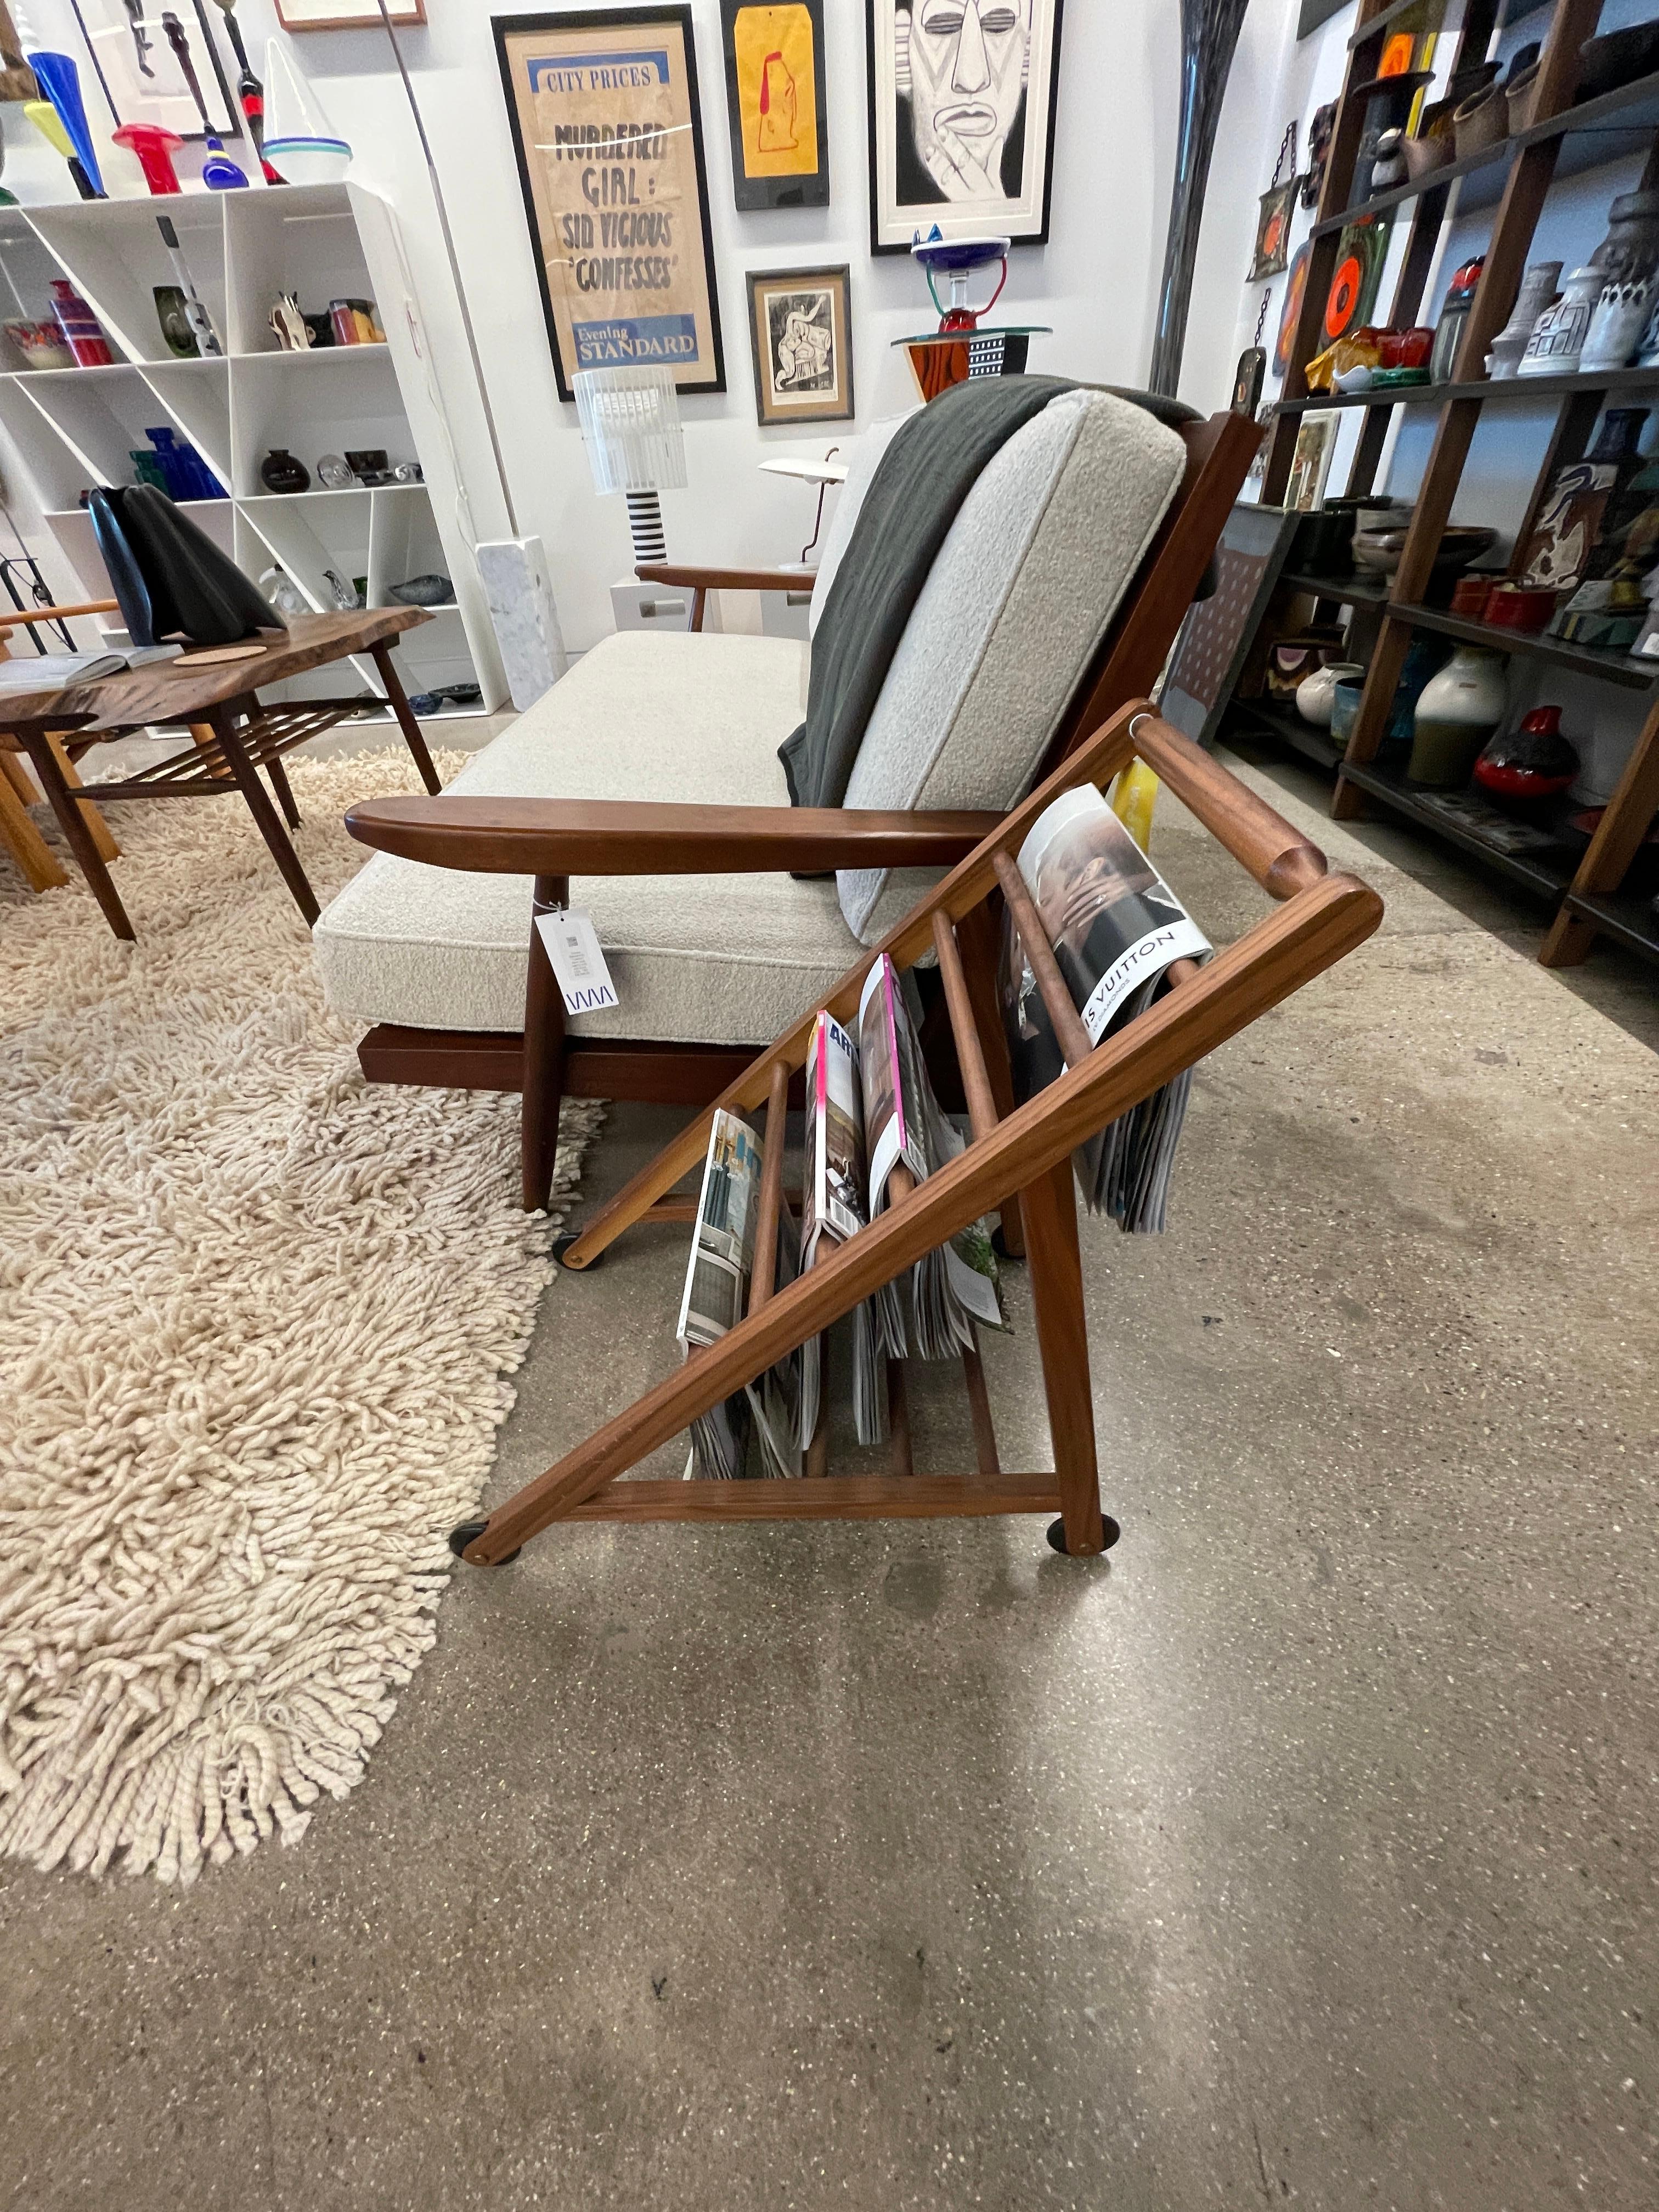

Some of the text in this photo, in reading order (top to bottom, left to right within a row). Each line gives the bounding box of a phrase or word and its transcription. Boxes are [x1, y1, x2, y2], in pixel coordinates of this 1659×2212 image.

[547, 65, 651, 92] CITY PRICES
[555, 122, 668, 161] MURDERED
[562, 211, 674, 249] SID VICIOUS
[578, 326, 629, 342] Evening
[580, 335, 695, 360] STANDARD
[1095, 932, 1175, 1003] VUITTON
